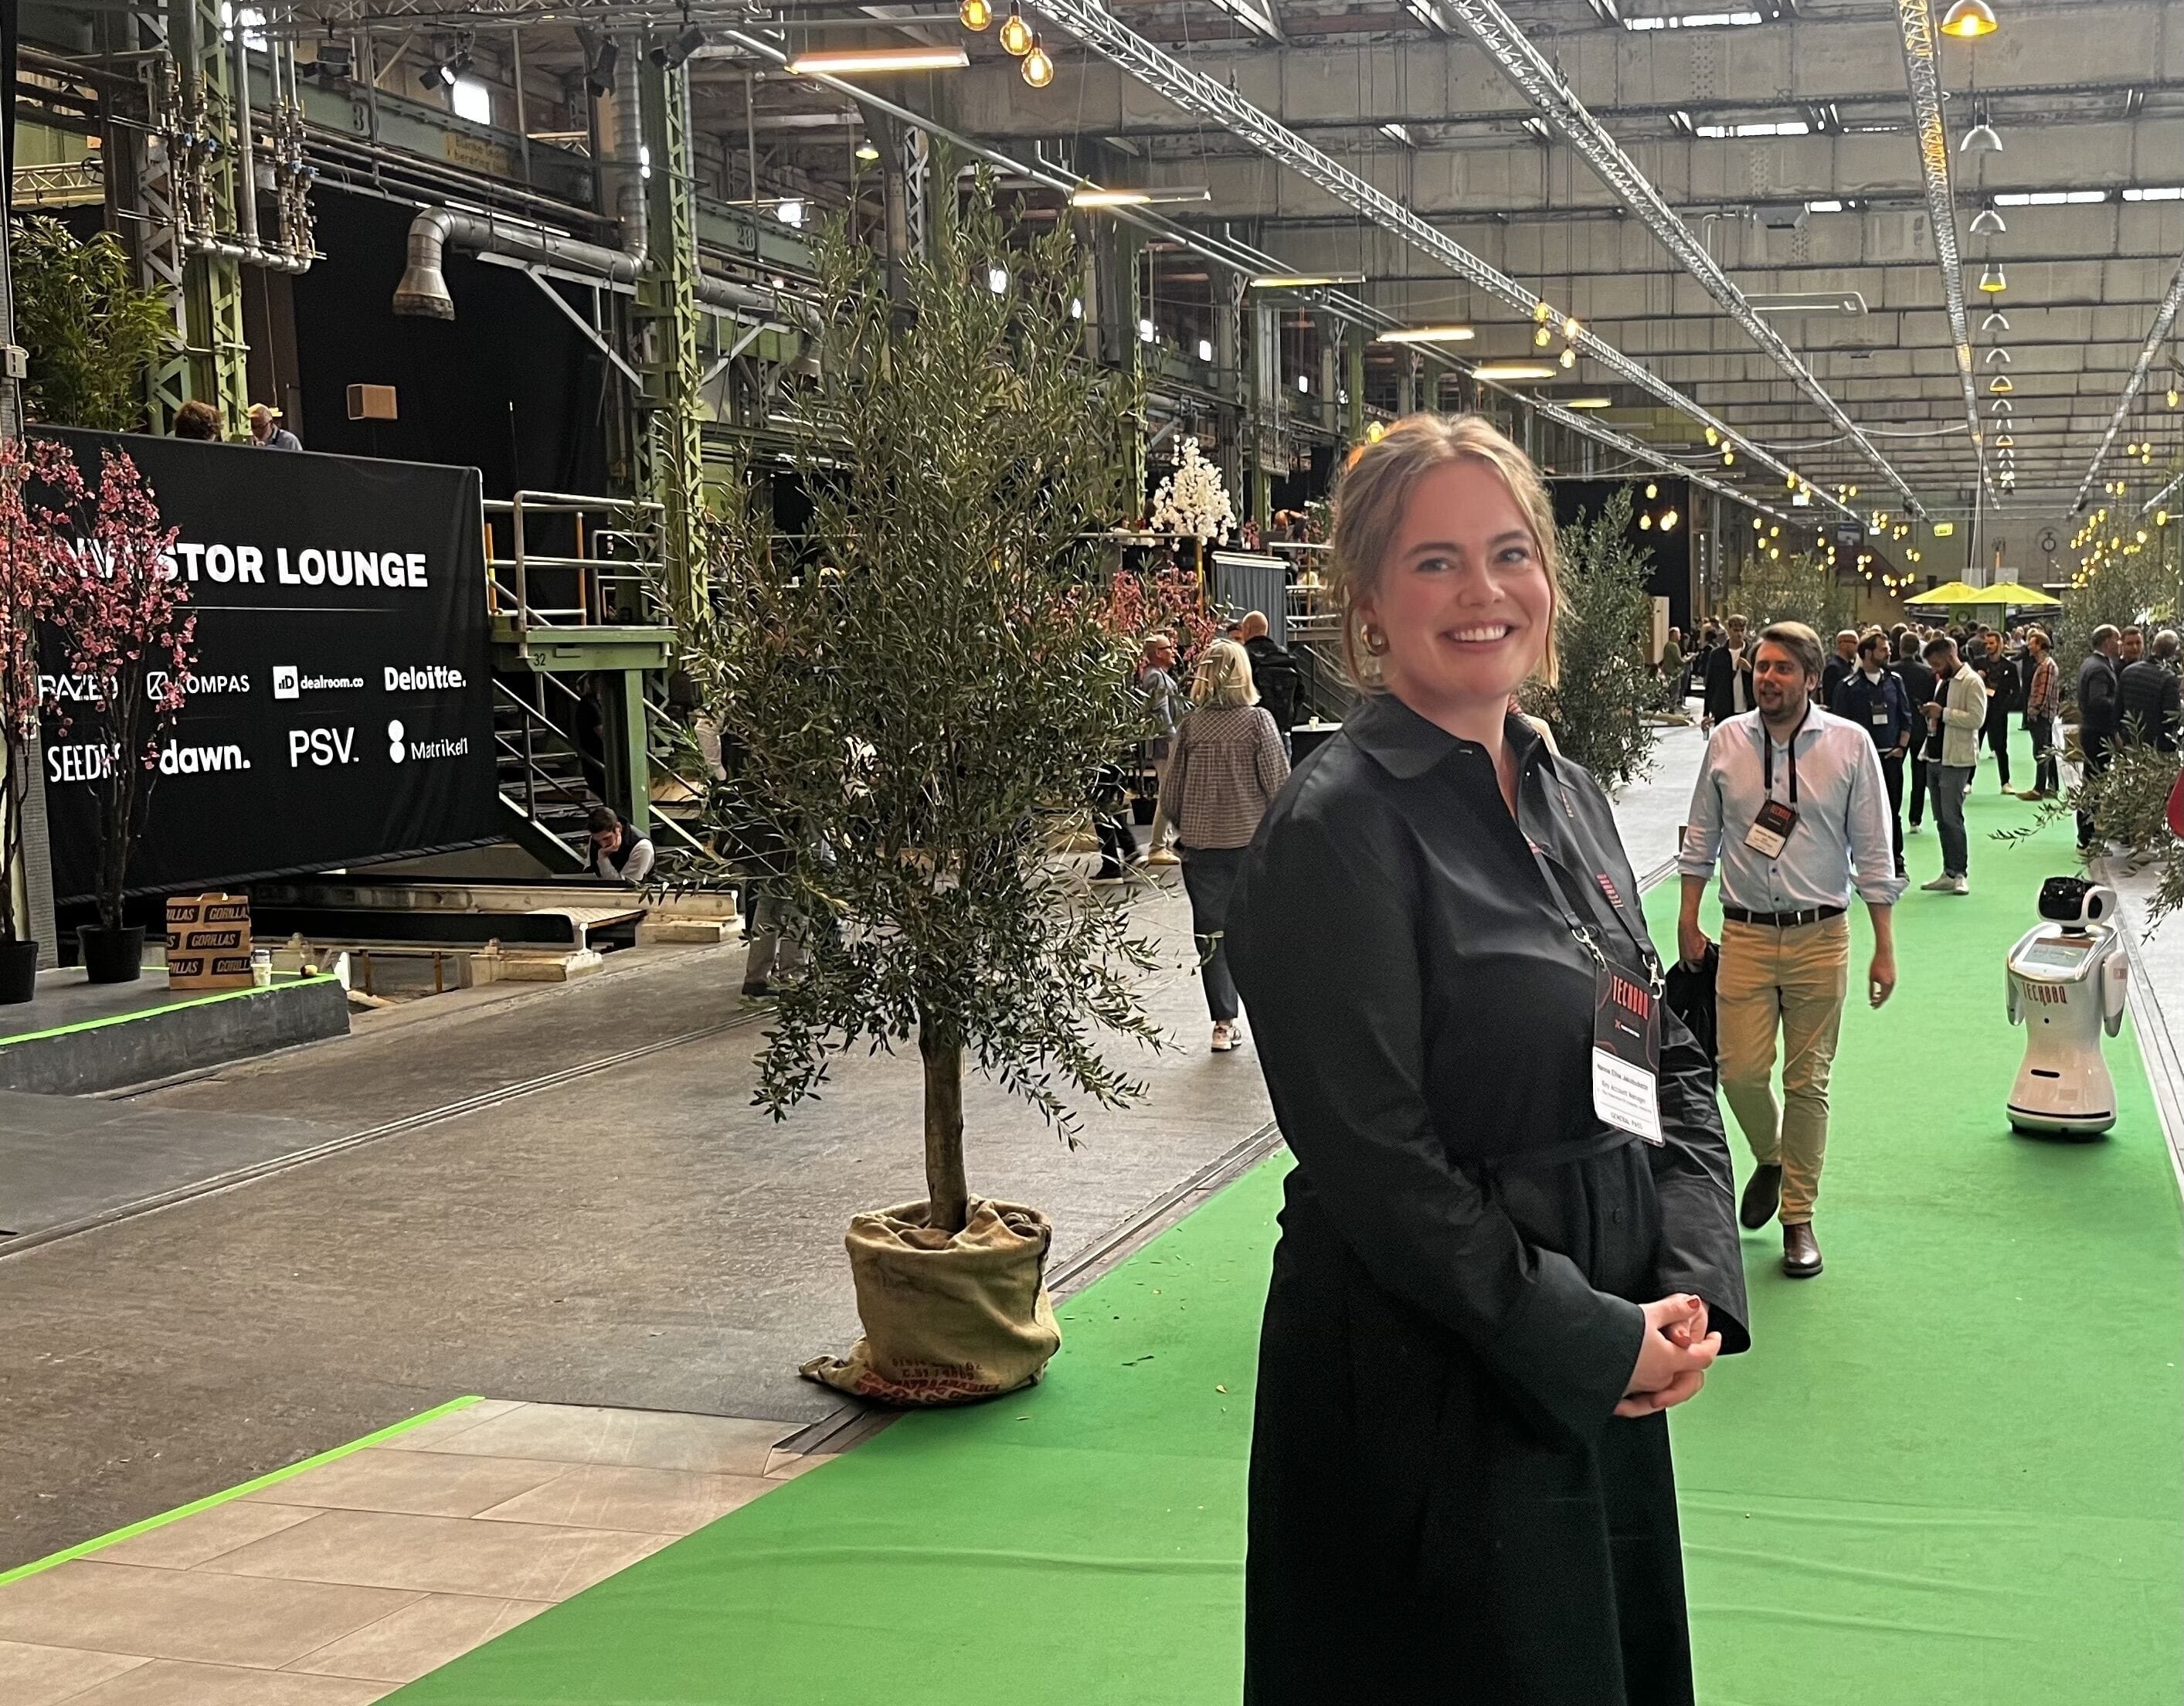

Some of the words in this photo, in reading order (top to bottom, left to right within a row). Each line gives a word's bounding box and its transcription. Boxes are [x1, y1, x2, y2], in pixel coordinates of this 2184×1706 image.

[277, 547, 428, 587] LOUNGE
[532, 653, 546, 667] 32
[175, 675, 250, 695] OMPAS
[300, 675, 364, 690] dealroom.co
[384, 665, 467, 692] Deloitte.
[159, 739, 251, 775] dawn.
[289, 727, 359, 767] PSV.
[192, 934, 236, 946] GORILLAS
